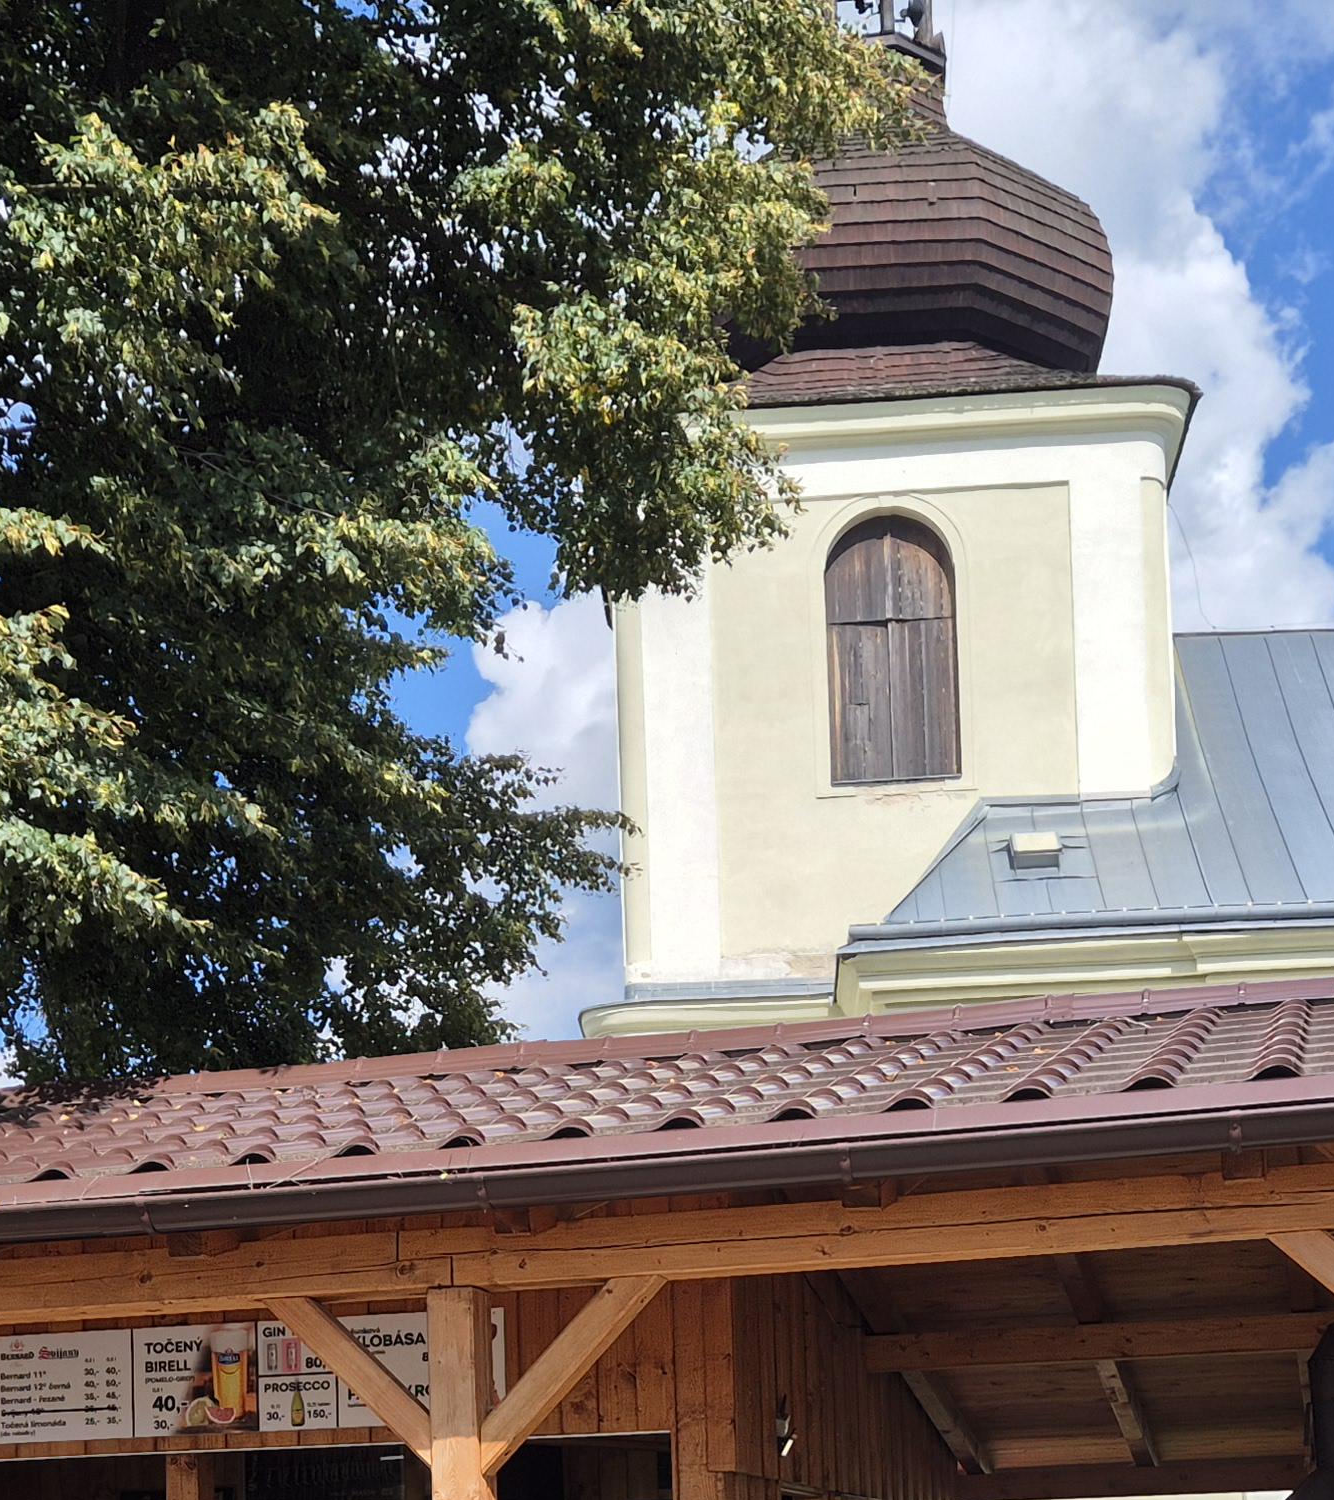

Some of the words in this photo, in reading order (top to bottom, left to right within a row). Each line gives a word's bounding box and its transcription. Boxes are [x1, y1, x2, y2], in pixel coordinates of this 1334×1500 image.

[262, 1326, 286, 1338] GIN
[144, 1336, 203, 1355] TOČENÝ
[145, 1359, 191, 1373] BIRELL
[0, 1372, 31, 1381] Bernard
[0, 1384, 31, 1393] Bernard
[264, 1380, 330, 1393] PROSECCO
[0, 1397, 31, 1405] Bernard
[152, 1395, 187, 1414] 40,-
[266, 1411, 285, 1421] 30,-
[307, 1409, 331, 1419] 150,-
[153, 1419, 173, 1430] 30,-
